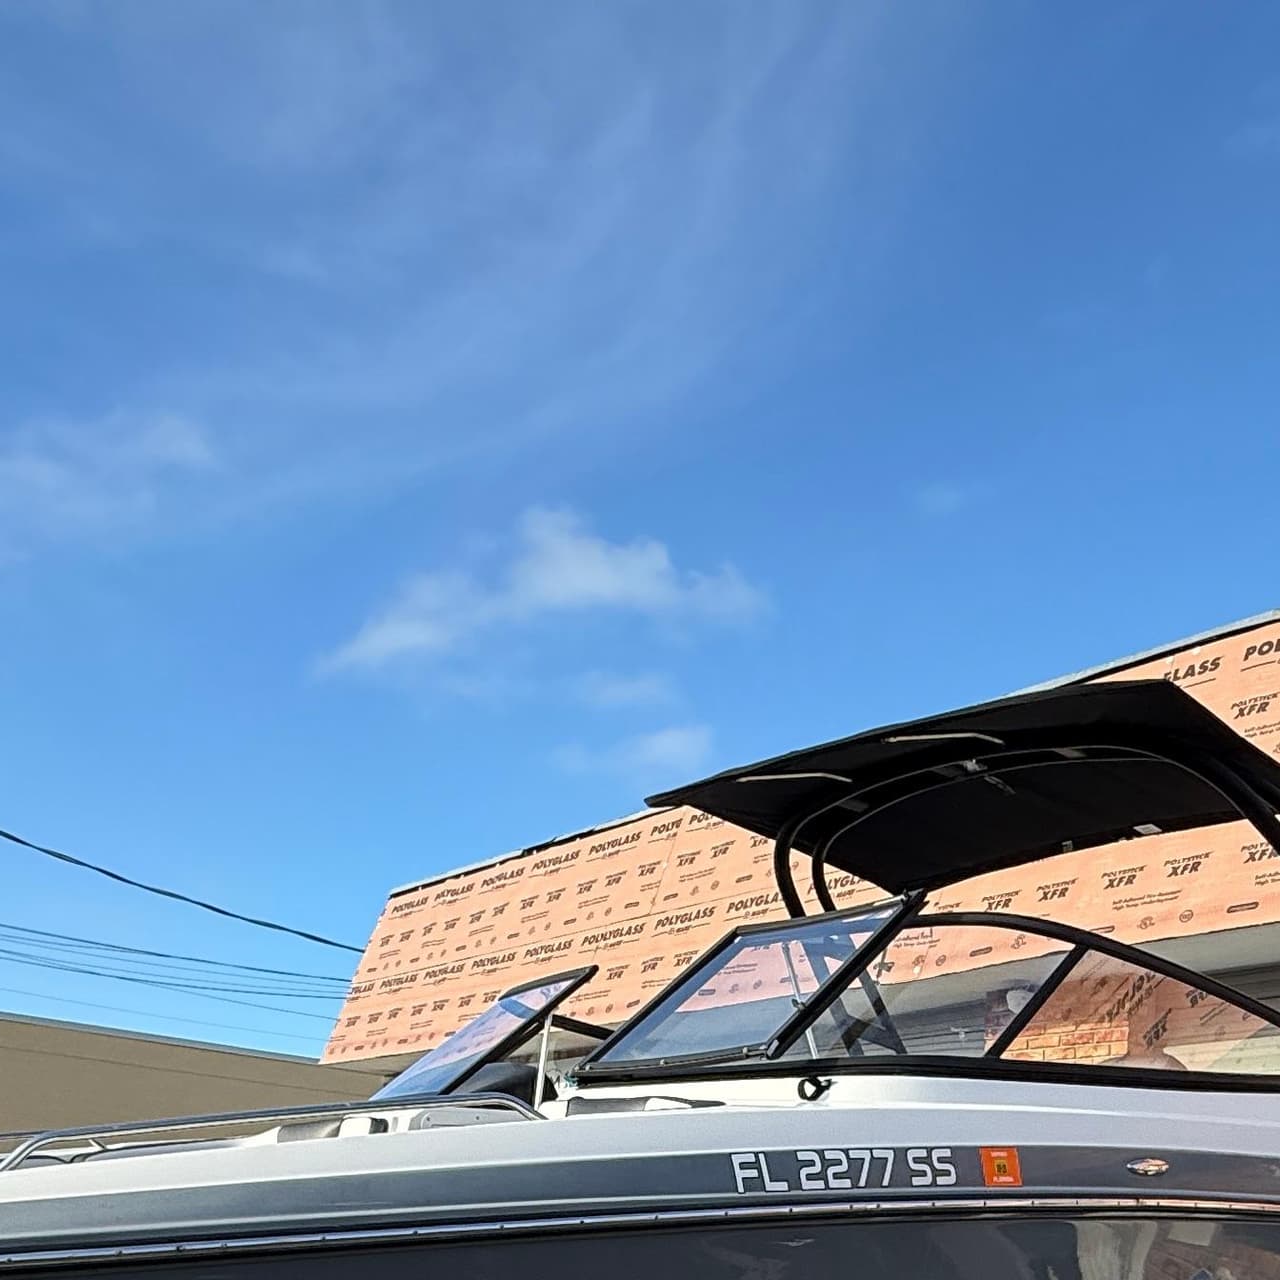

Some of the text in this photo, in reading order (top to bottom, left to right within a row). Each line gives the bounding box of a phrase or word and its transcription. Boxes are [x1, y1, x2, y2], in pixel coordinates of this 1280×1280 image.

[1230, 691, 1280, 710] POLYSTICK
[1231, 700, 1270, 719] XFR
[588, 831, 643, 856] POLYGLASS
[710, 846, 729, 859] XFR
[531, 850, 581, 872] POLYGLASS
[676, 856, 696, 867] XFR
[638, 865, 656, 877] XFR
[1166, 861, 1202, 878] XFR
[605, 873, 625, 887] XFR
[1103, 874, 1137, 890] XFR
[576, 883, 594, 895] XFR
[1037, 886, 1069, 902] XFR
[983, 898, 1012, 915] XFR
[654, 906, 717, 931] POLYGLASS
[523, 939, 574, 959] POLYGLASS
[471, 952, 518, 970] POLYGLASS
[641, 962, 658, 974] XFR
[673, 956, 692, 967] XFR
[606, 970, 624, 981] XFR
[730, 1147, 957, 1194] FL 2277 SS
